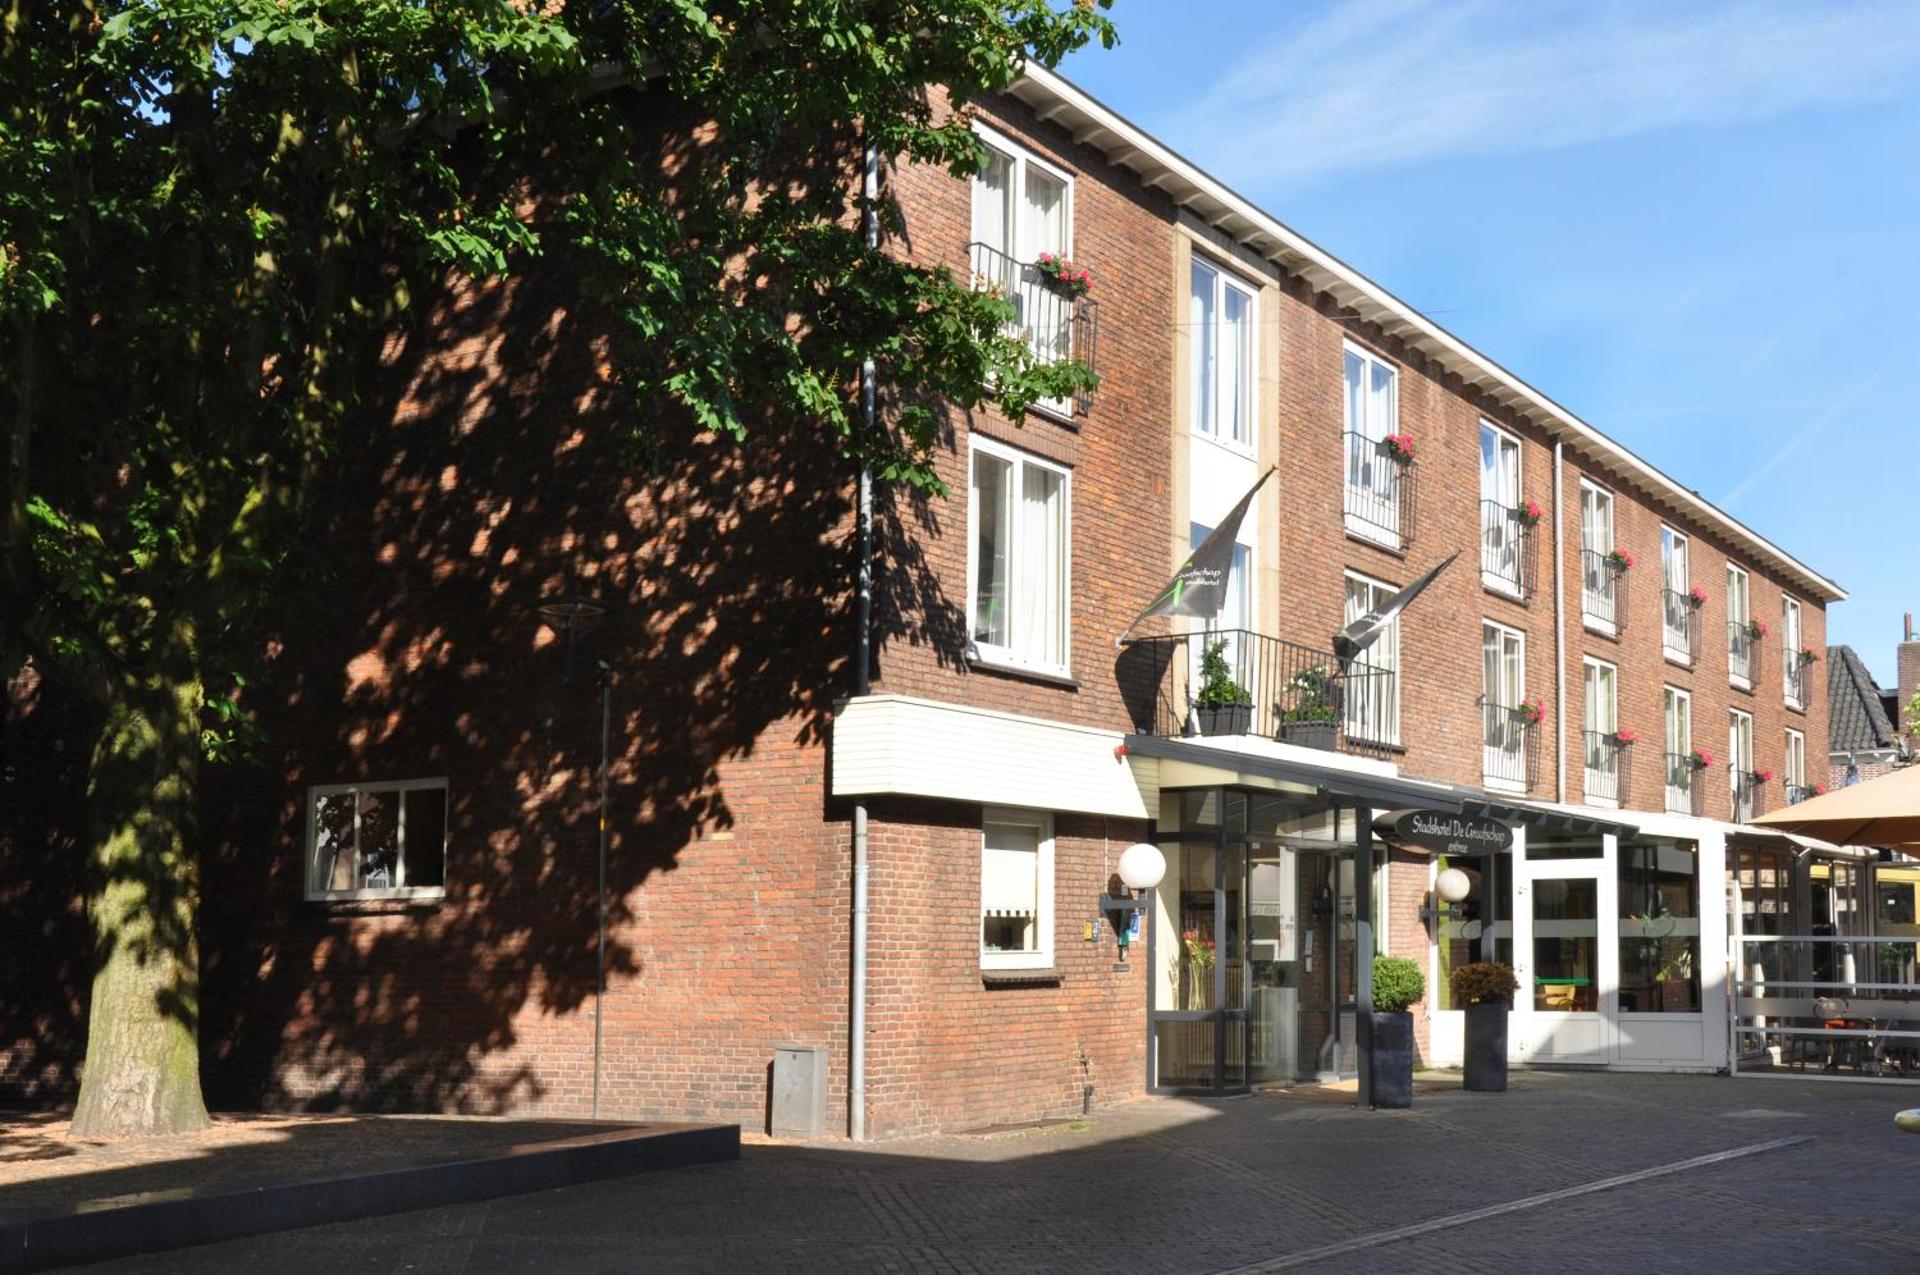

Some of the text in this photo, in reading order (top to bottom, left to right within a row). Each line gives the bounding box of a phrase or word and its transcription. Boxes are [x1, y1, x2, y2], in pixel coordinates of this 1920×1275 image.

[1412, 815, 1505, 848] Stadshotel De Graafschap
[1448, 842, 1469, 854] entree
